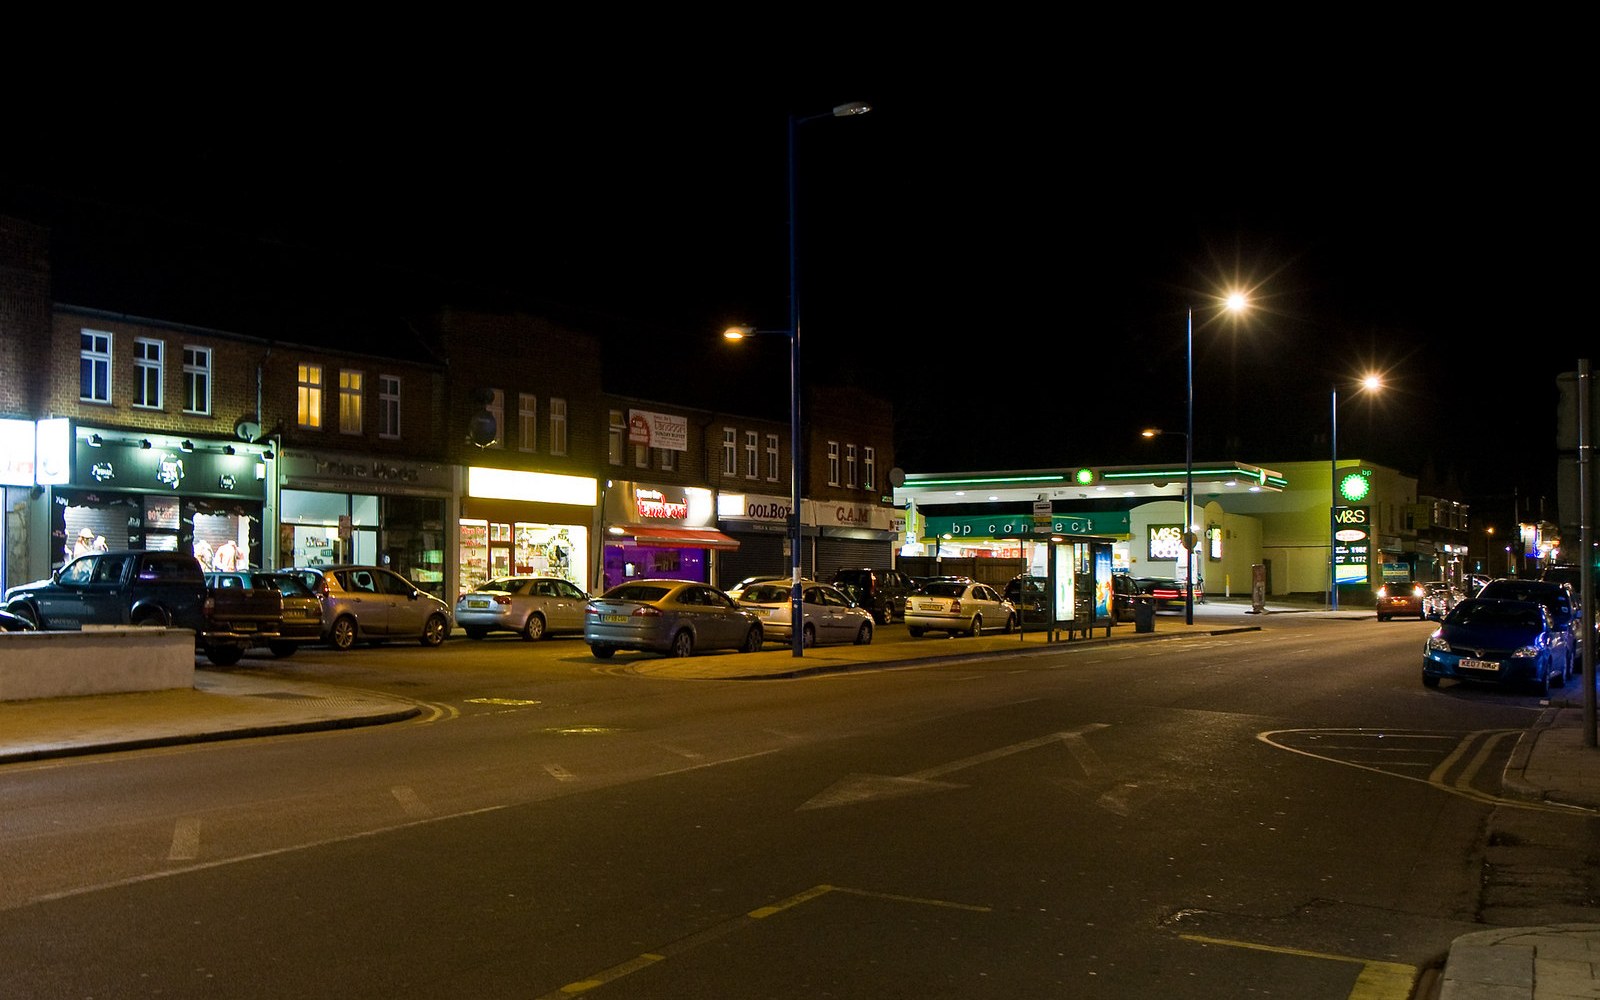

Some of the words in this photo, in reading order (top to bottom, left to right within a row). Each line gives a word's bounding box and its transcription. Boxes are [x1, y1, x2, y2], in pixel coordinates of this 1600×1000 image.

[1361, 469, 1372, 477] bp
[748, 503, 792, 520] OOLBOX
[952, 522, 972, 535] bp
[988, 519, 1093, 534] conect
[1151, 527, 1181, 541] M&S
